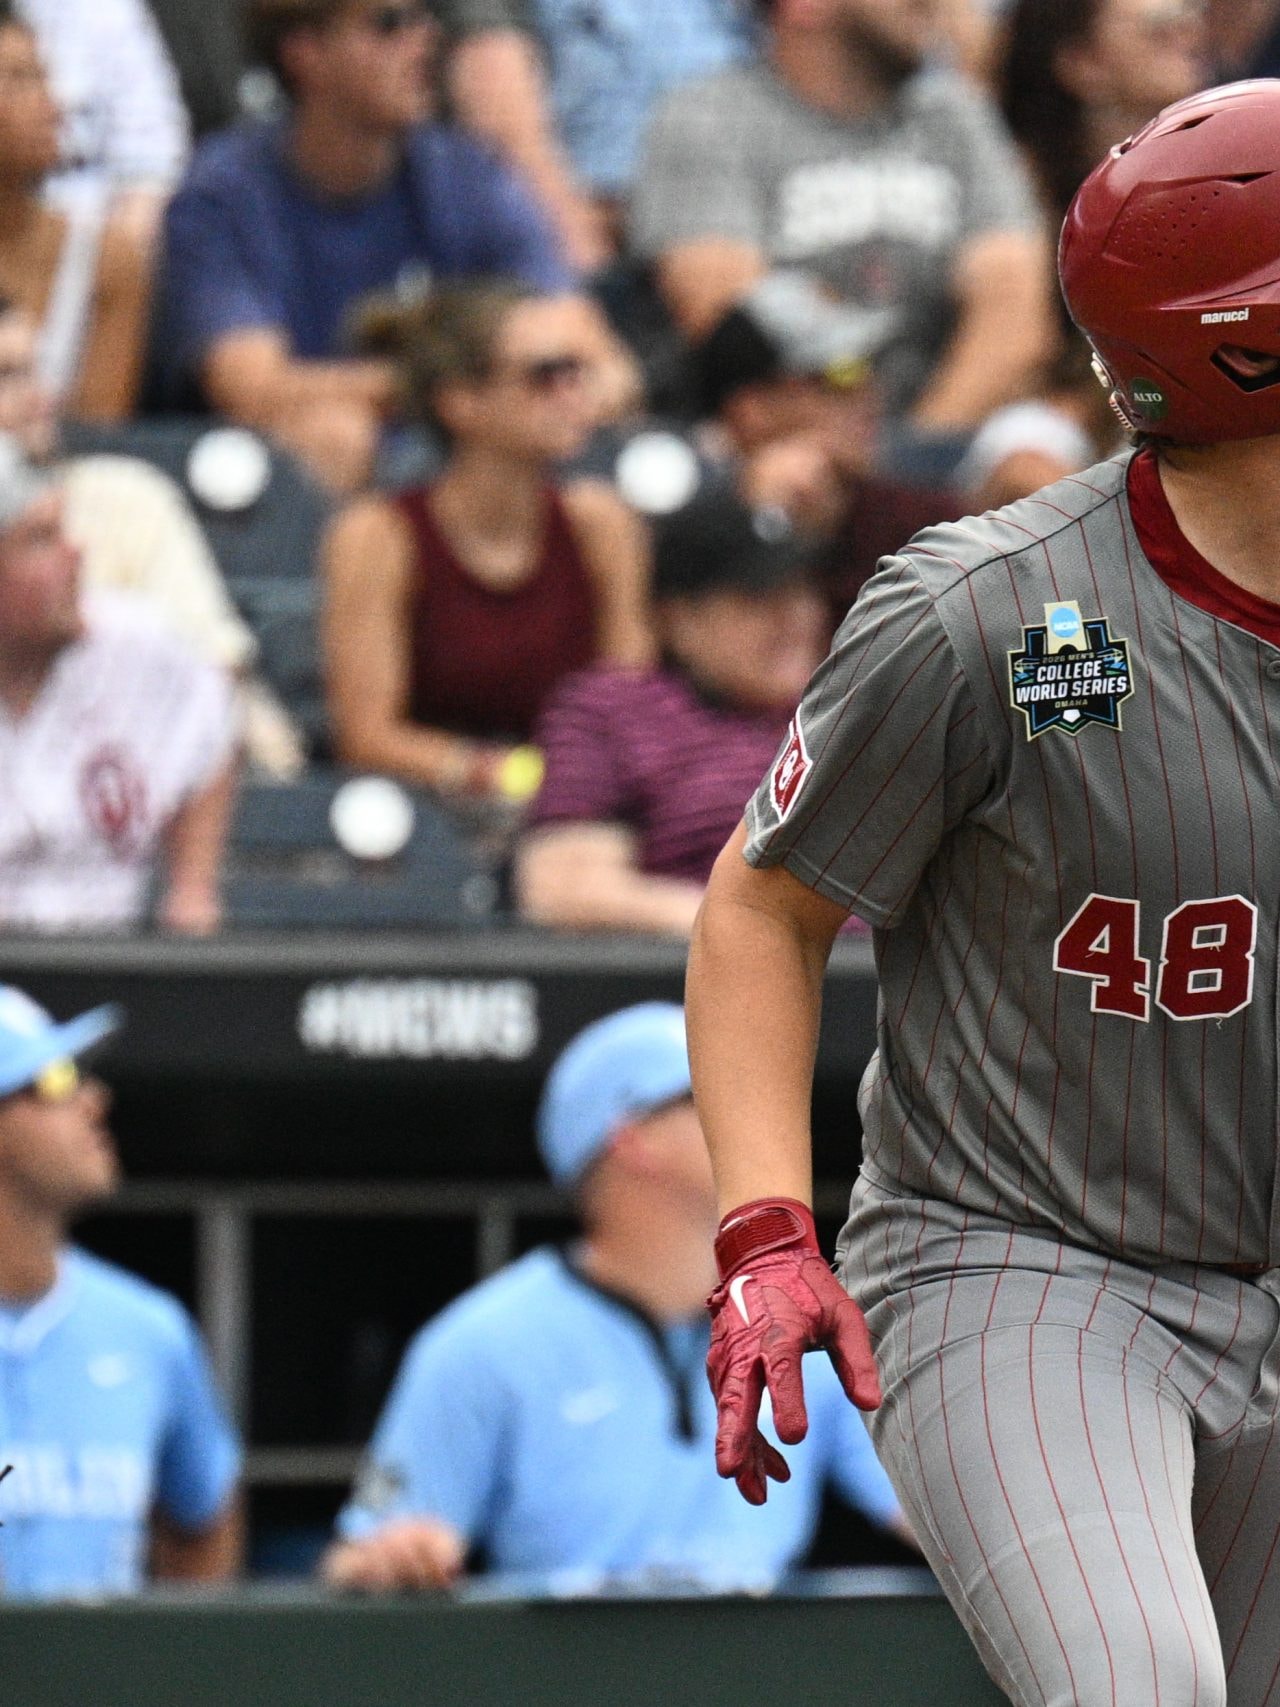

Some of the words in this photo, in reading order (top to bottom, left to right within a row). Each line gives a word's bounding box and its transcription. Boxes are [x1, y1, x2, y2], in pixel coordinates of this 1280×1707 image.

[1201, 307, 1249, 324] marucci
[1133, 392, 1163, 402] ALTO
[1036, 660, 1103, 682] COLLEGE
[1016, 682, 1069, 704] WORLD
[1071, 676, 1128, 697] SERIES
[1055, 699, 1089, 709] OMAHA
[1053, 893, 1259, 1023] 48
